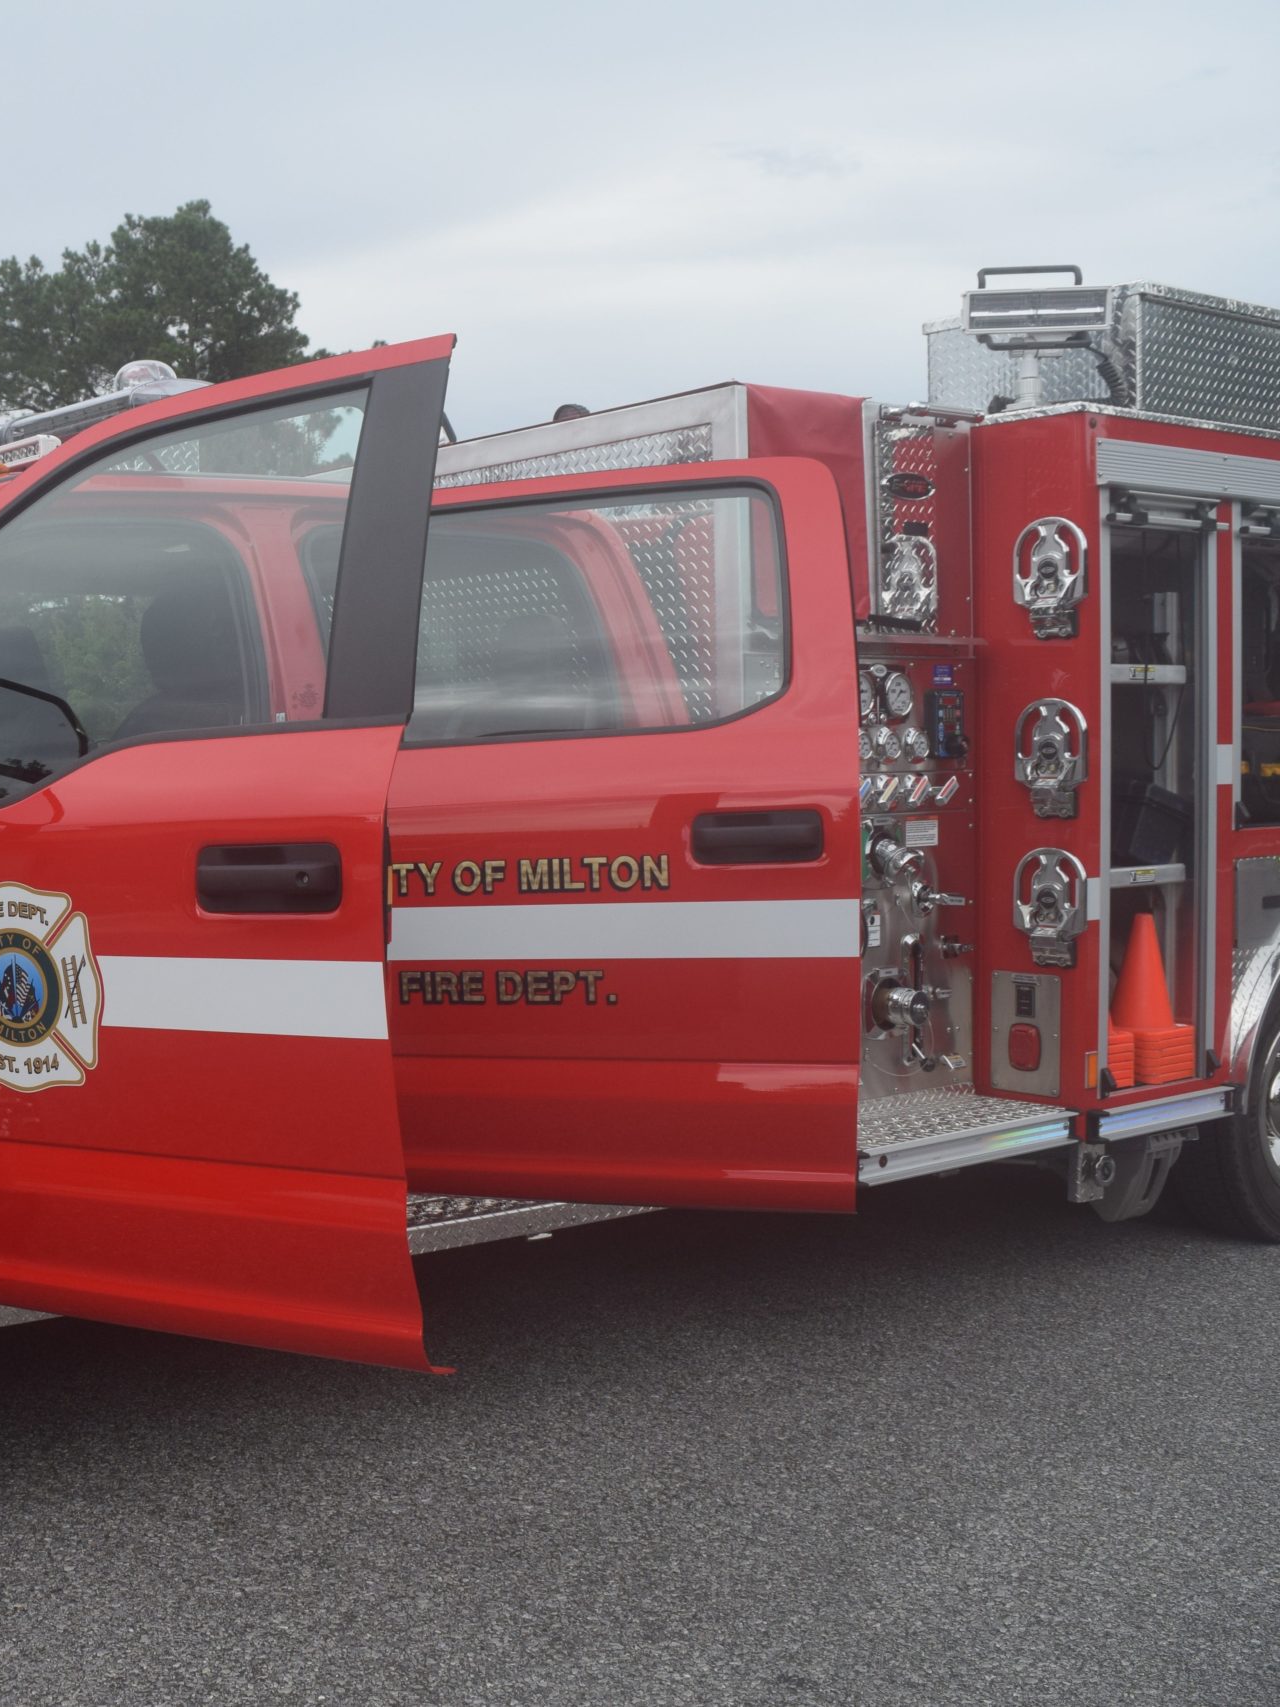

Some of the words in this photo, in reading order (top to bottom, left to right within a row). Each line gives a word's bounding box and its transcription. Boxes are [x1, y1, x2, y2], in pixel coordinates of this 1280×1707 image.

[388, 862, 442, 896] TY
[452, 859, 506, 894] OF
[518, 853, 670, 893] MILTON
[7, 900, 49, 926] DEPT.
[22, 937, 43, 956] OF
[399, 970, 486, 1005] FIRE
[496, 970, 618, 1005] DEPT.
[23, 1053, 60, 1074] 1914
